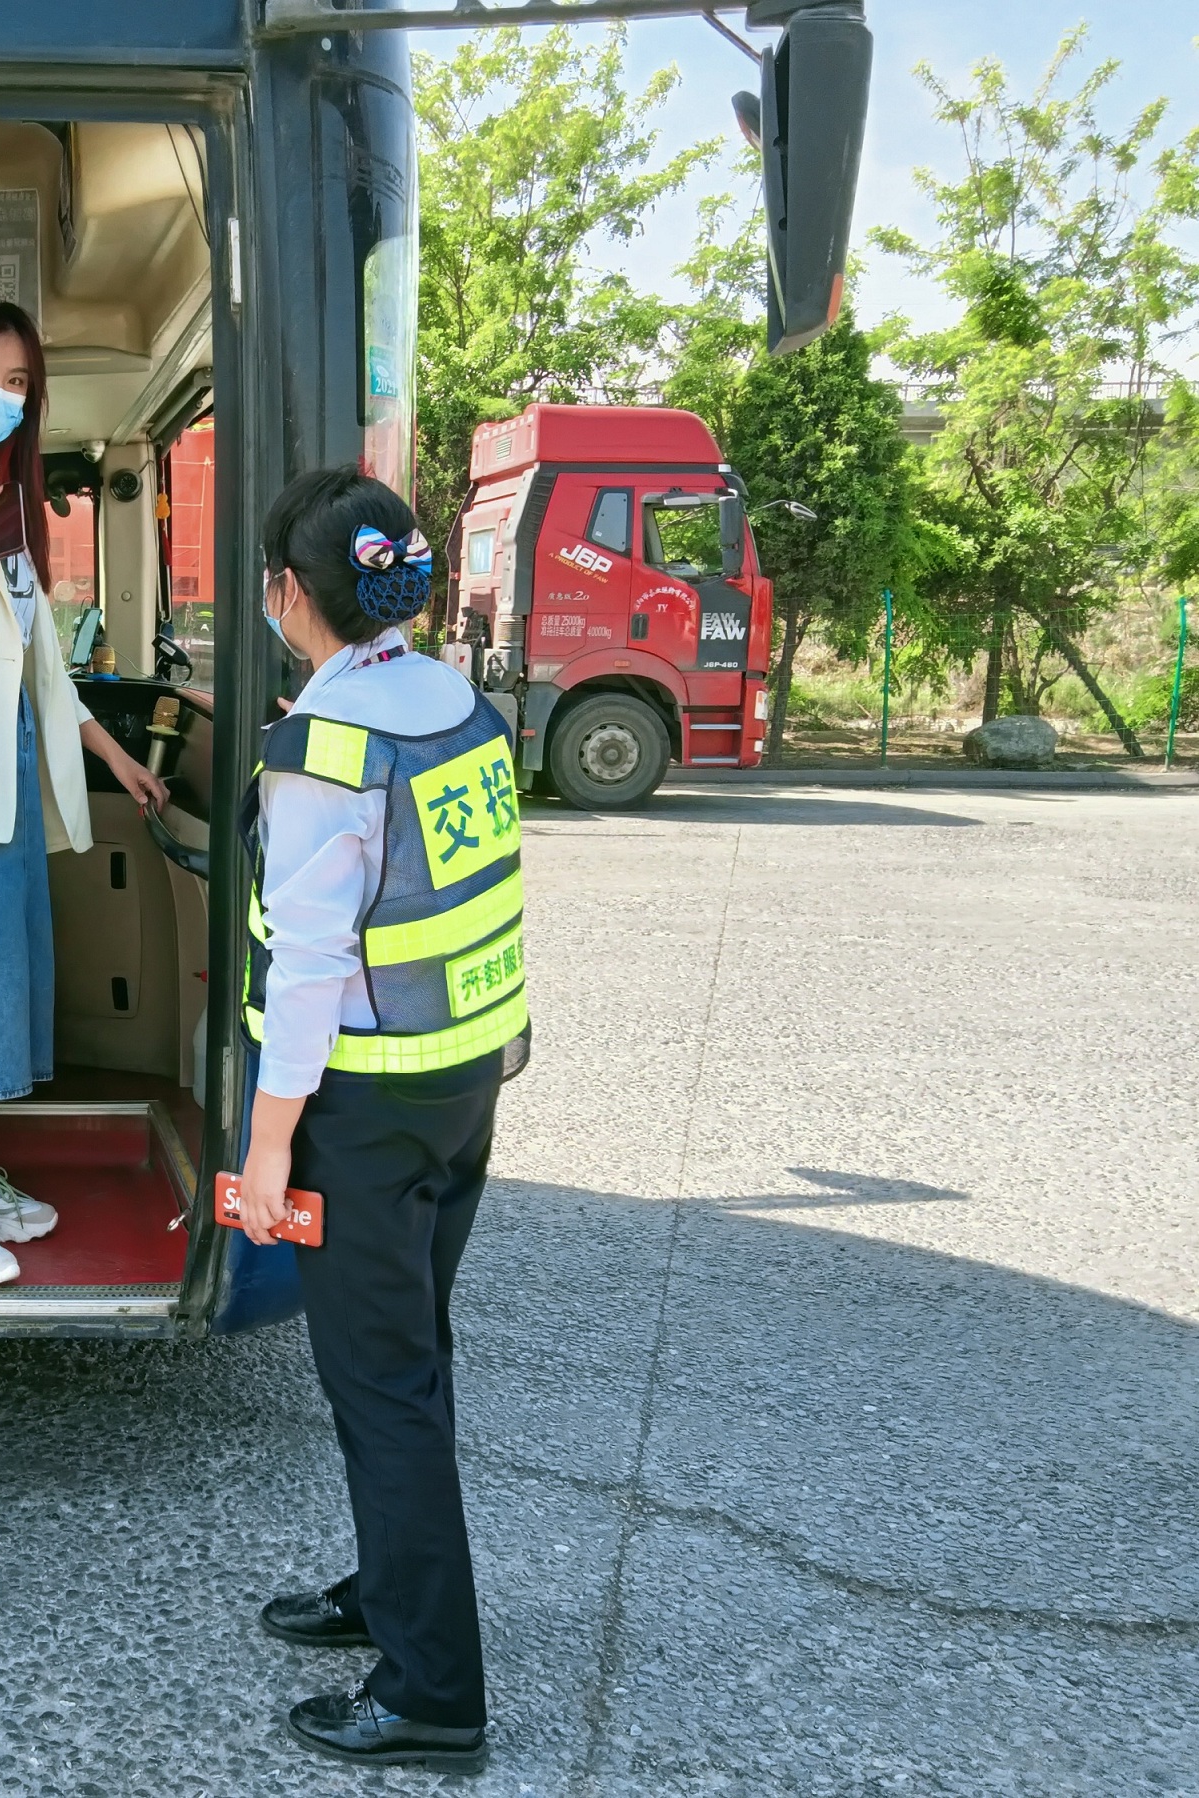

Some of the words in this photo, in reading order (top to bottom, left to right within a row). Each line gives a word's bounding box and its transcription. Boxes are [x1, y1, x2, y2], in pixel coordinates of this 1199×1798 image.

[560, 544, 613, 573] J6P
[554, 555, 584, 572] PRODUCT
[593, 573, 609, 584] FAW
[655, 603, 669, 612] JY
[587, 626, 612, 639] 40000kg
[700, 627, 746, 640] FAW
[426, 758, 519, 865] 交投
